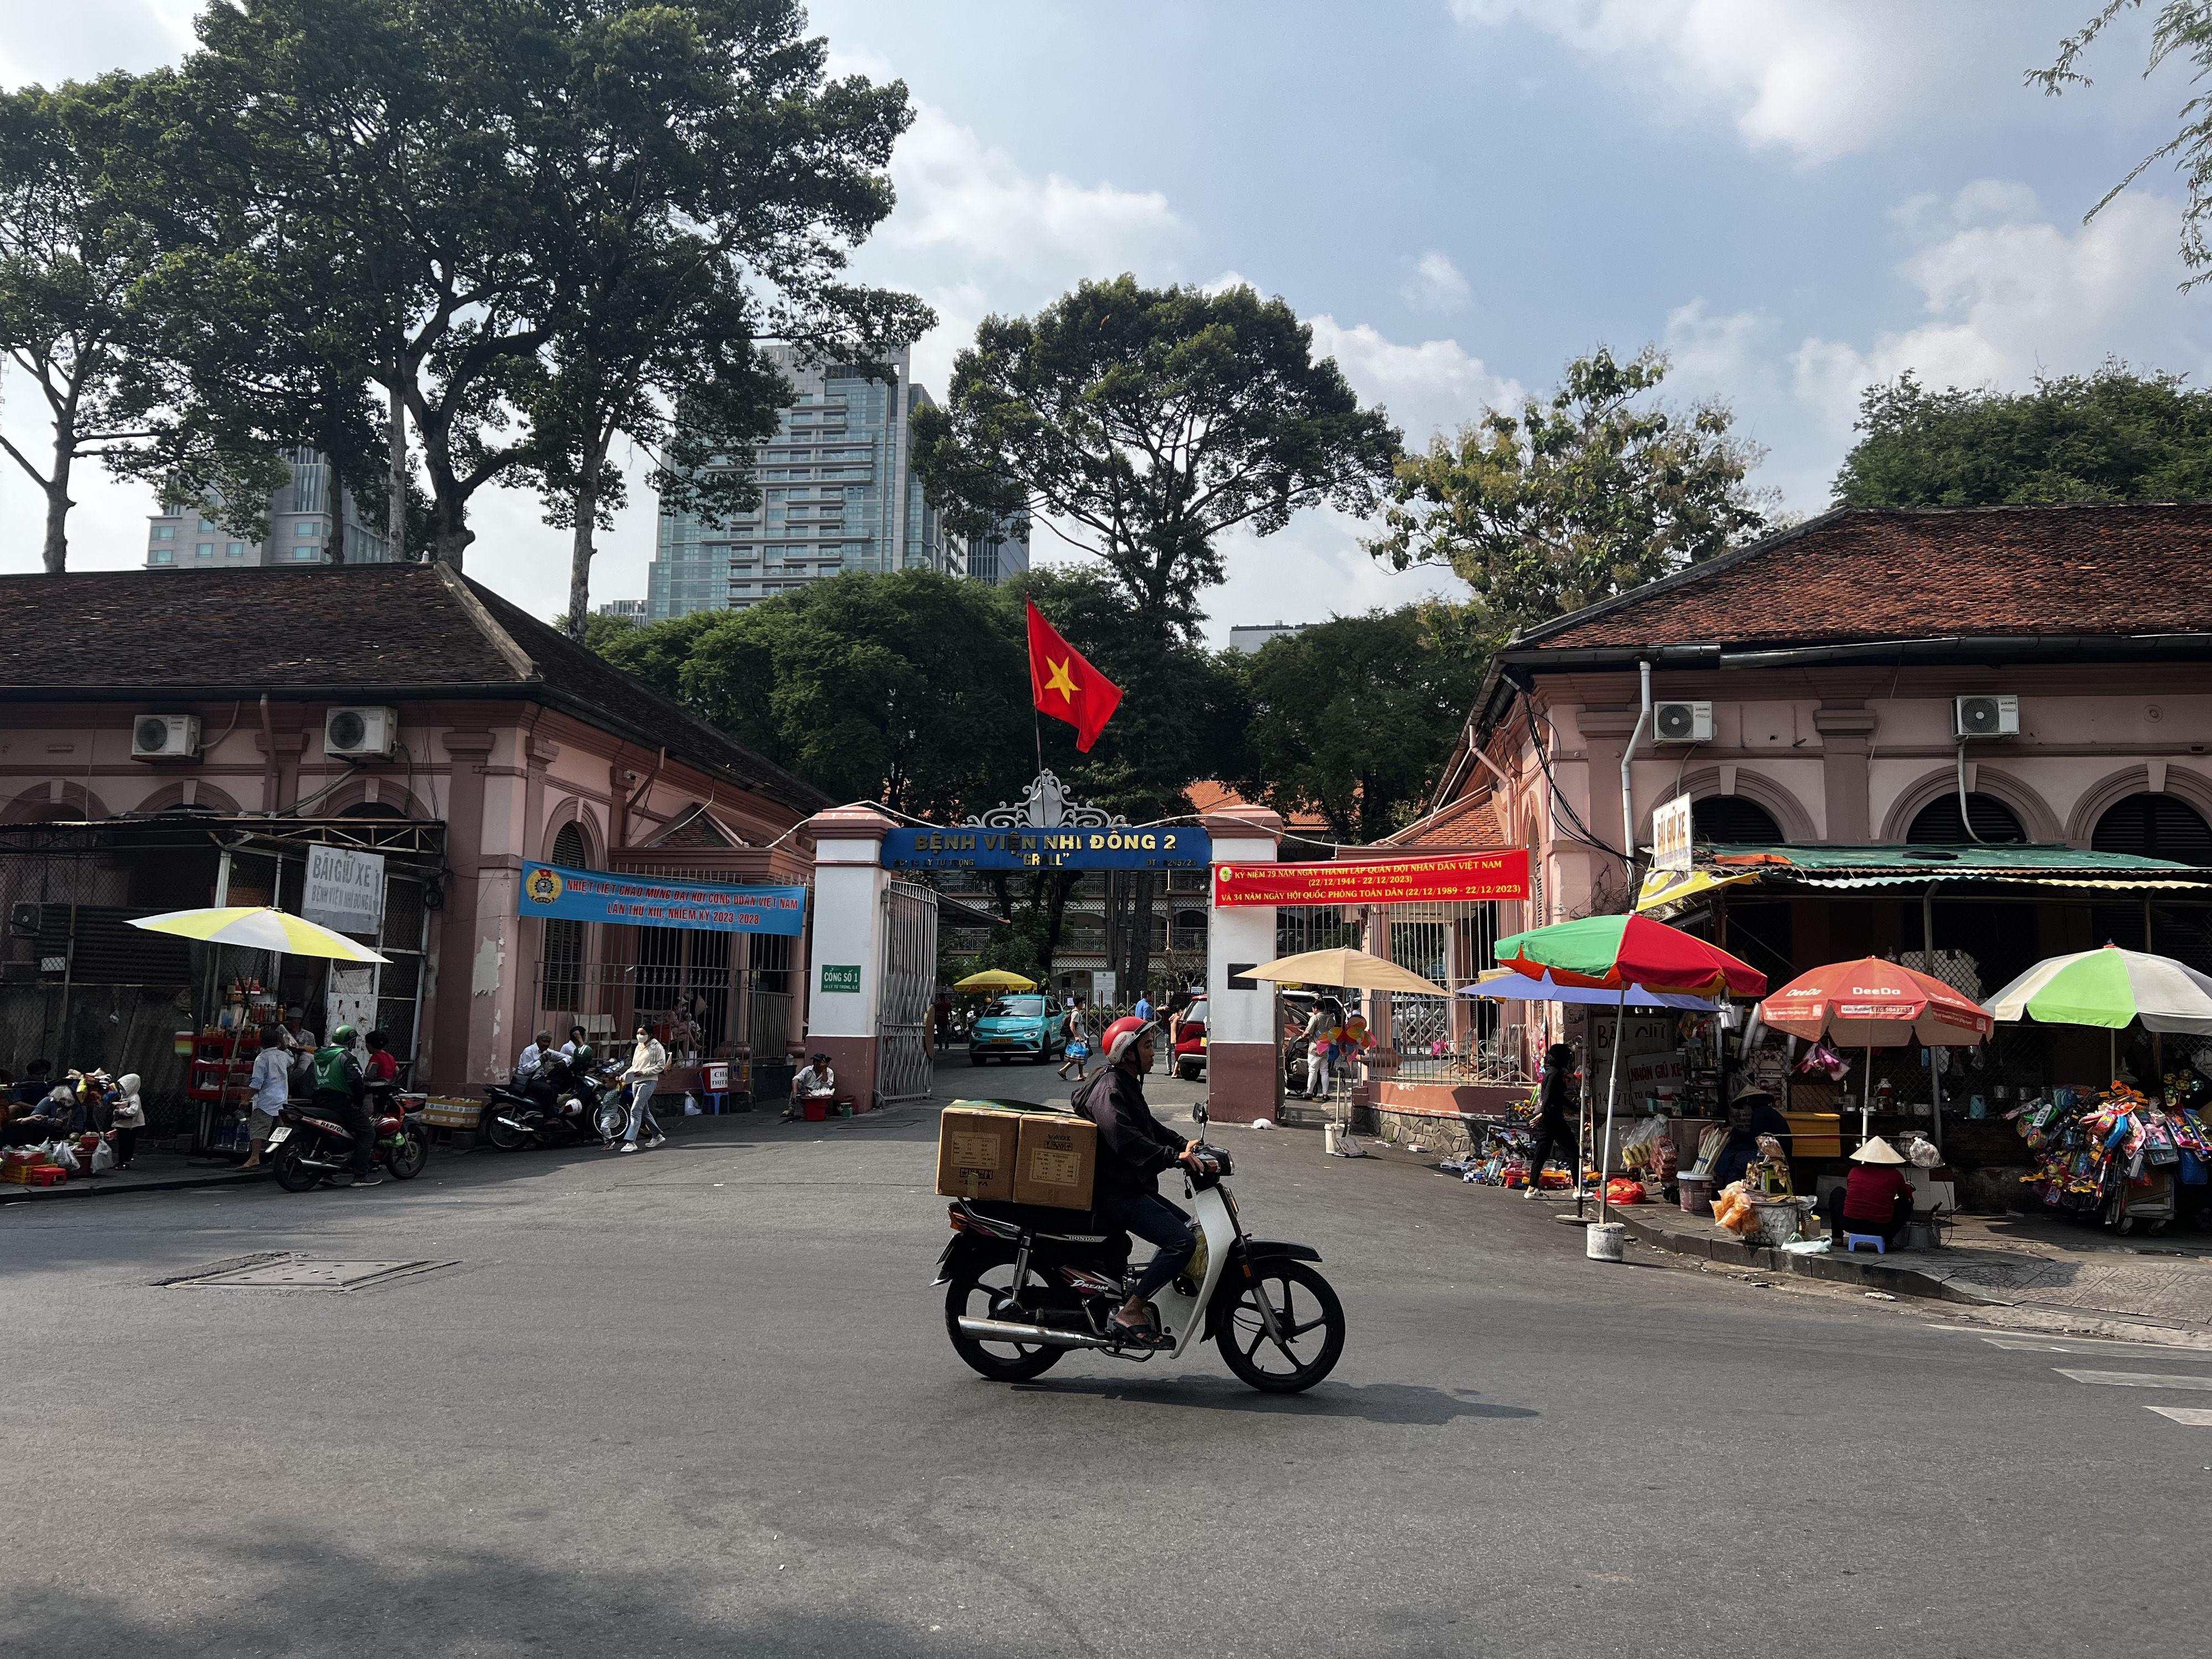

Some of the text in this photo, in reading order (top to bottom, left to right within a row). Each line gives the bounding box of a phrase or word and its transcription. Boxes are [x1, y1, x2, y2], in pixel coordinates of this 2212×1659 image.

[1677, 811, 1686, 840] XE
[915, 831, 975, 854] BỆNH
[984, 831, 1036, 854] VIỆN
[1044, 835, 1082, 849] NHI
[1164, 835, 1176, 849] 2
[312, 852, 372, 887] BÃI GIỮ XE
[1247, 869, 1265, 879] NIỆM
[1278, 869, 1295, 877] NĂM
[1297, 868, 1317, 877] NGÀY
[1321, 867, 1348, 875] THÀNH
[1352, 865, 1365, 875] LẬP
[1368, 865, 1392, 874] QUÂN
[1394, 863, 1408, 873] ĐỘI
[1410, 863, 1434, 872] NHÂN
[1437, 862, 1456, 870] DÂN
[1458, 860, 1479, 870] VIỆT
[1308, 878, 1355, 887] (22/12/1944
[567, 879, 798, 911] NHIỆT LIỆT CHÀO MỪNG ĐẠI HỘI CÔNG ĐOÀN VIỆT NAM
[1221, 892, 1232, 901] VÀ
[1245, 892, 1261, 900] NĂM
[1264, 891, 1285, 900] NGÀY
[1287, 890, 1301, 901] HỘI
[1303, 888, 1326, 900] QUỐC
[1328, 889, 1357, 898] PHÒNG
[1359, 888, 1382, 897] TOÀN
[1385, 887, 1404, 896] DÂN
[1406, 886, 1458, 897] (22/12/1989
[1465, 884, 1521, 894] 22/12/2023)
[607, 900, 625, 915] LẦN
[668, 907, 696, 921] NHIỆM
[824, 968, 858, 982] CỔNG SỐ 1
[1785, 988, 1822, 997] DeeDa
[1670, 1063, 1682, 1077] XE
